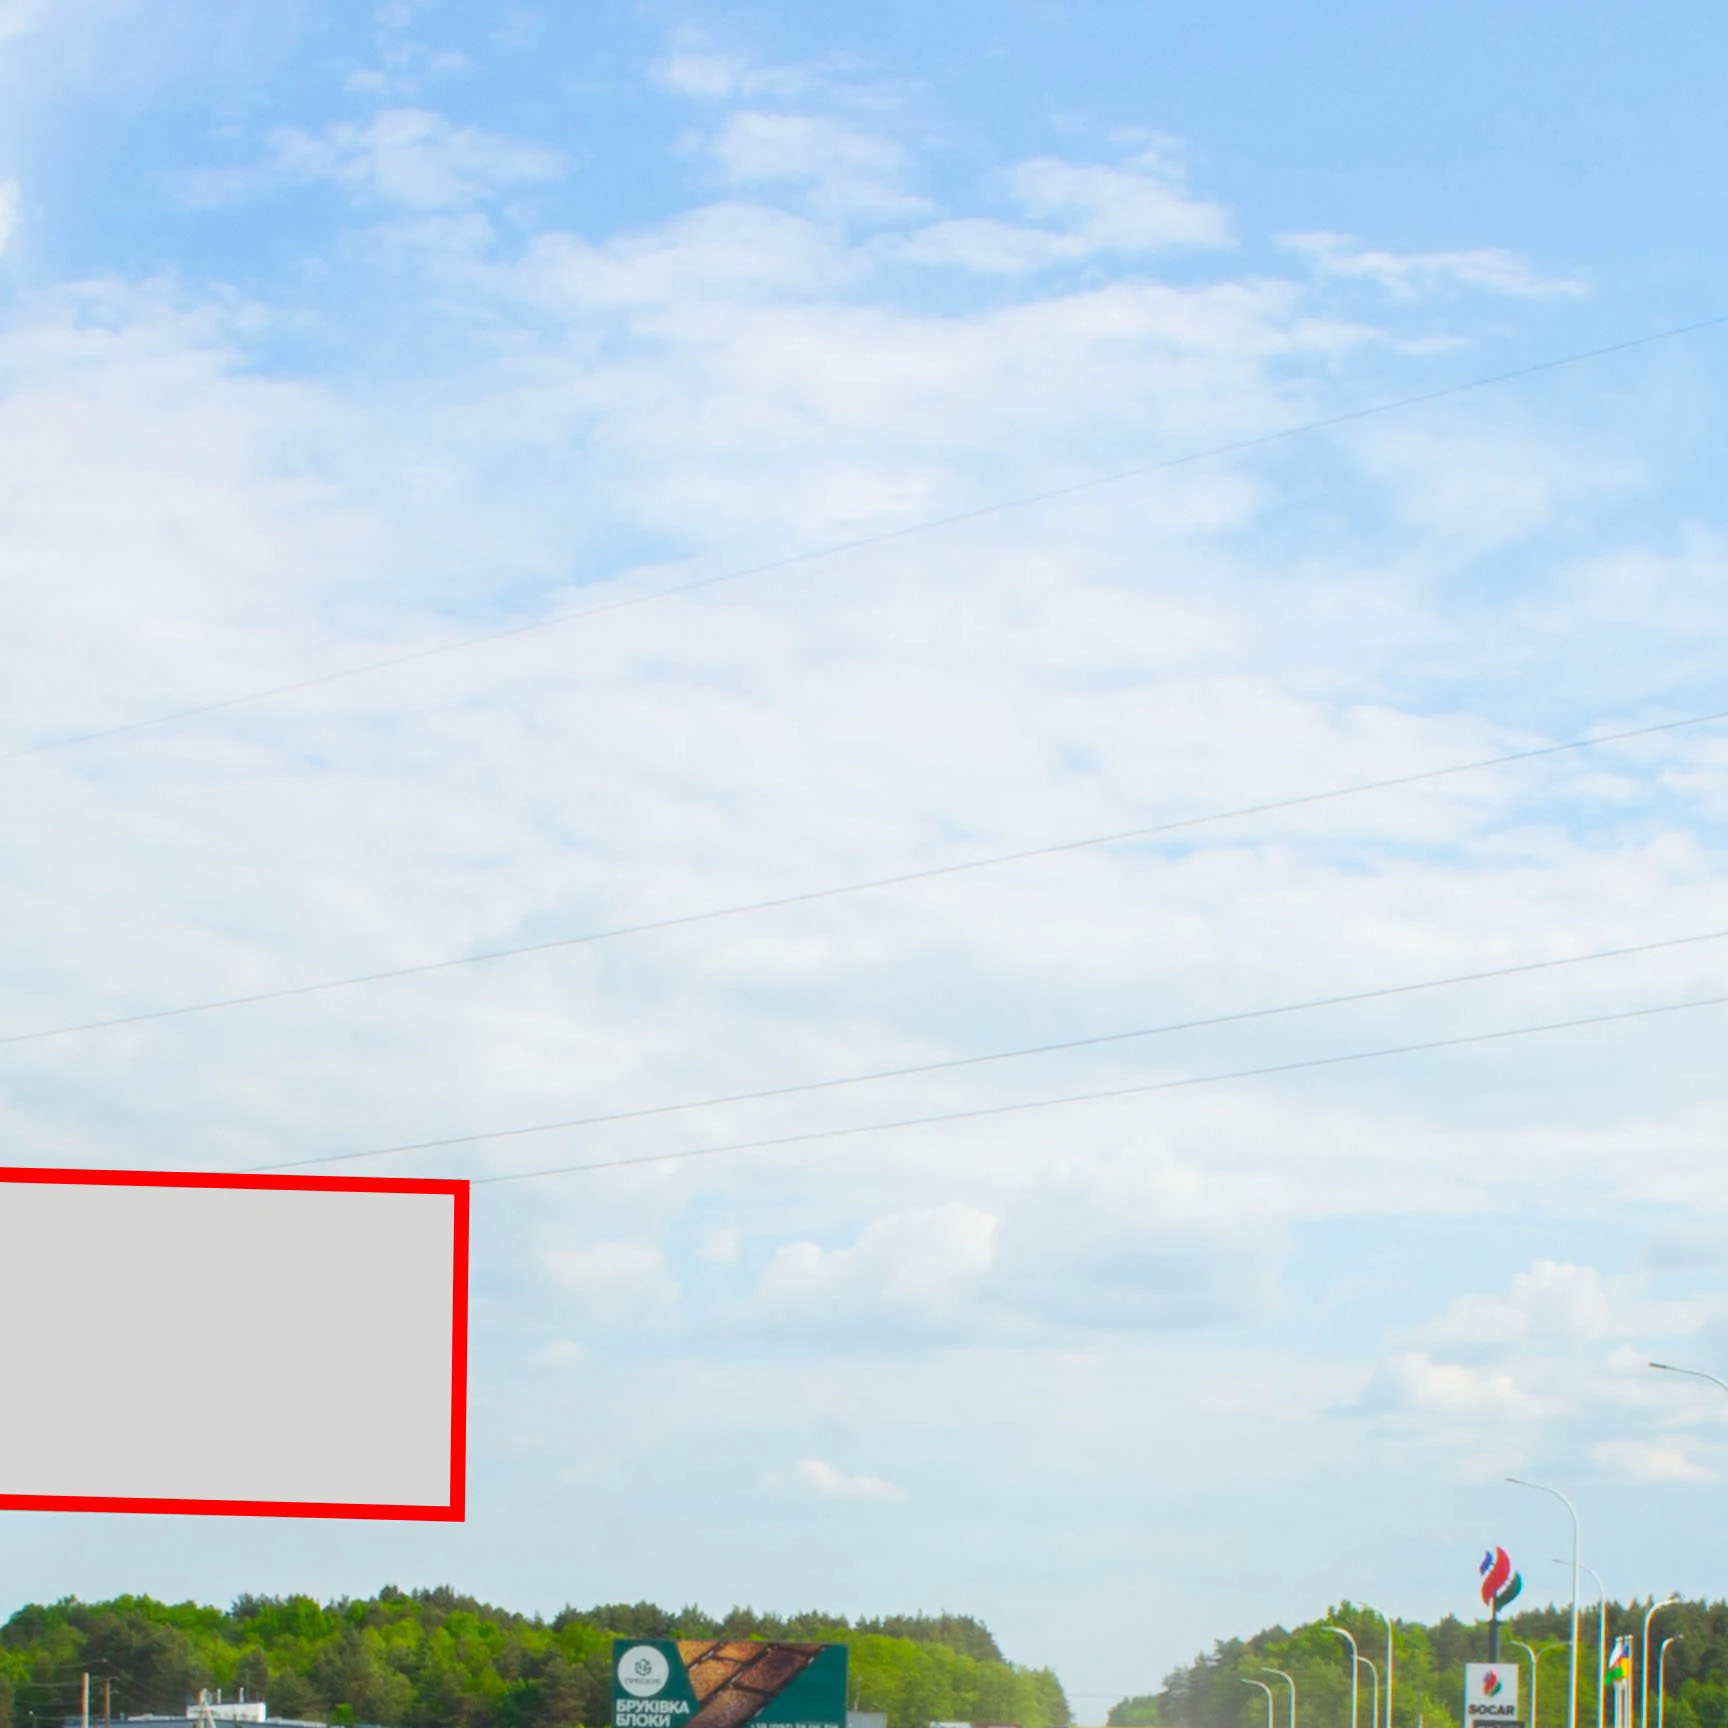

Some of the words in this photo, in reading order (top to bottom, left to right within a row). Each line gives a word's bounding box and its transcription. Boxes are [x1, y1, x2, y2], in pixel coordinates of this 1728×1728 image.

[616, 1699, 690, 1714] БРУКІВКА
[1468, 1704, 1514, 1715] SOCAR
[616, 1714, 671, 1727] БЛОКИ
